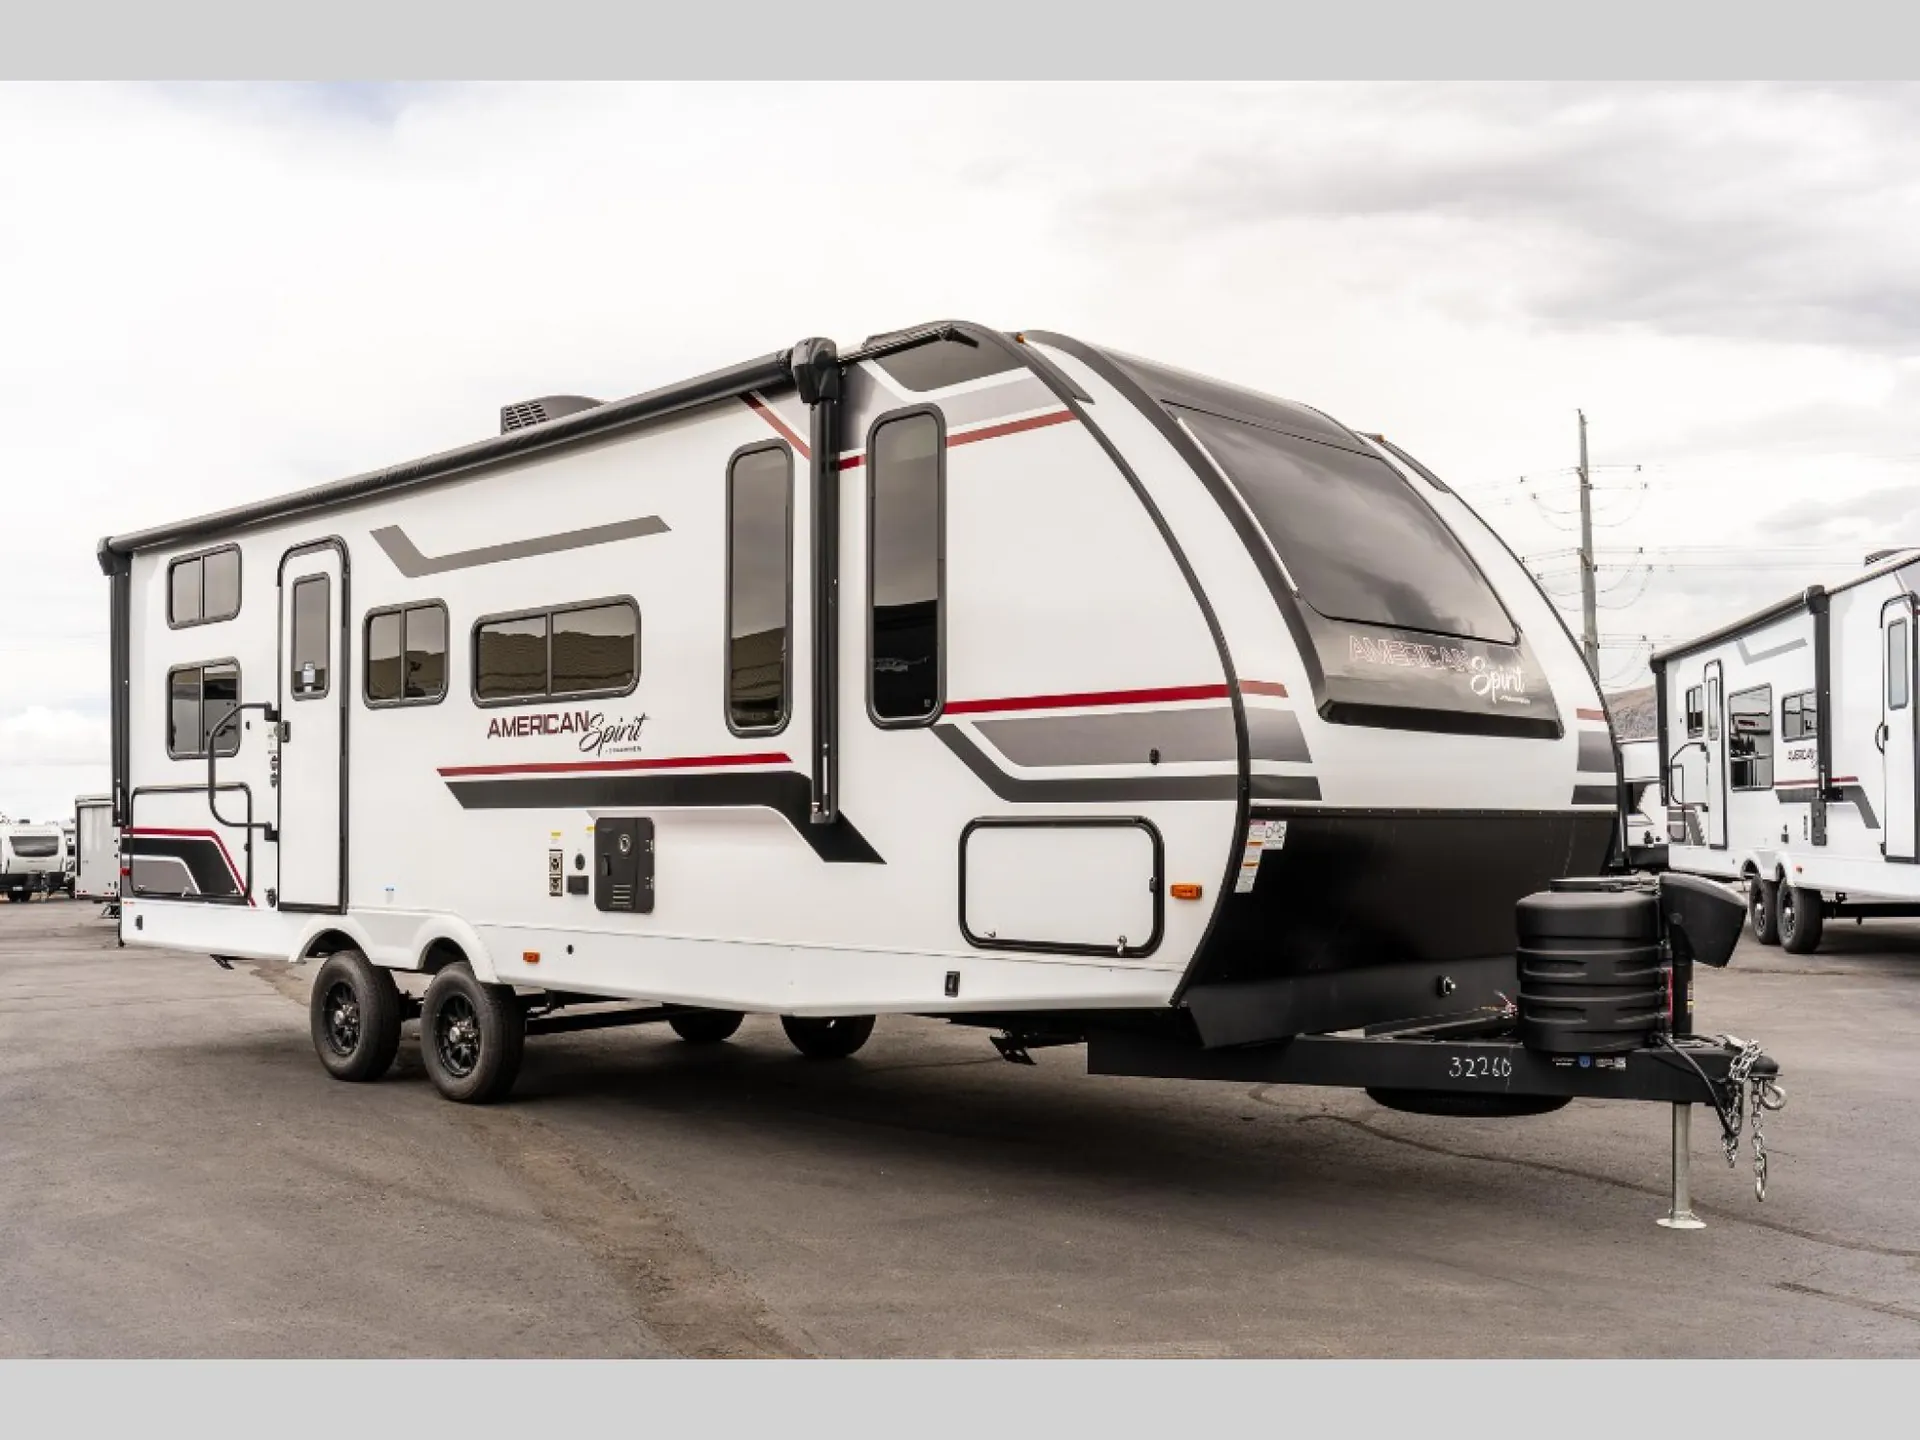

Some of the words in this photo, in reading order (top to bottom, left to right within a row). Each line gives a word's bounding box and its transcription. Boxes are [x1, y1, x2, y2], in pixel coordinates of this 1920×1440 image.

[1350, 635, 1477, 673] AMERICAN
[1470, 656, 1526, 703] Spirit
[487, 710, 590, 738] AMERICAN
[579, 712, 650, 757] Spirit
[1449, 1056, 1512, 1078] 32260
